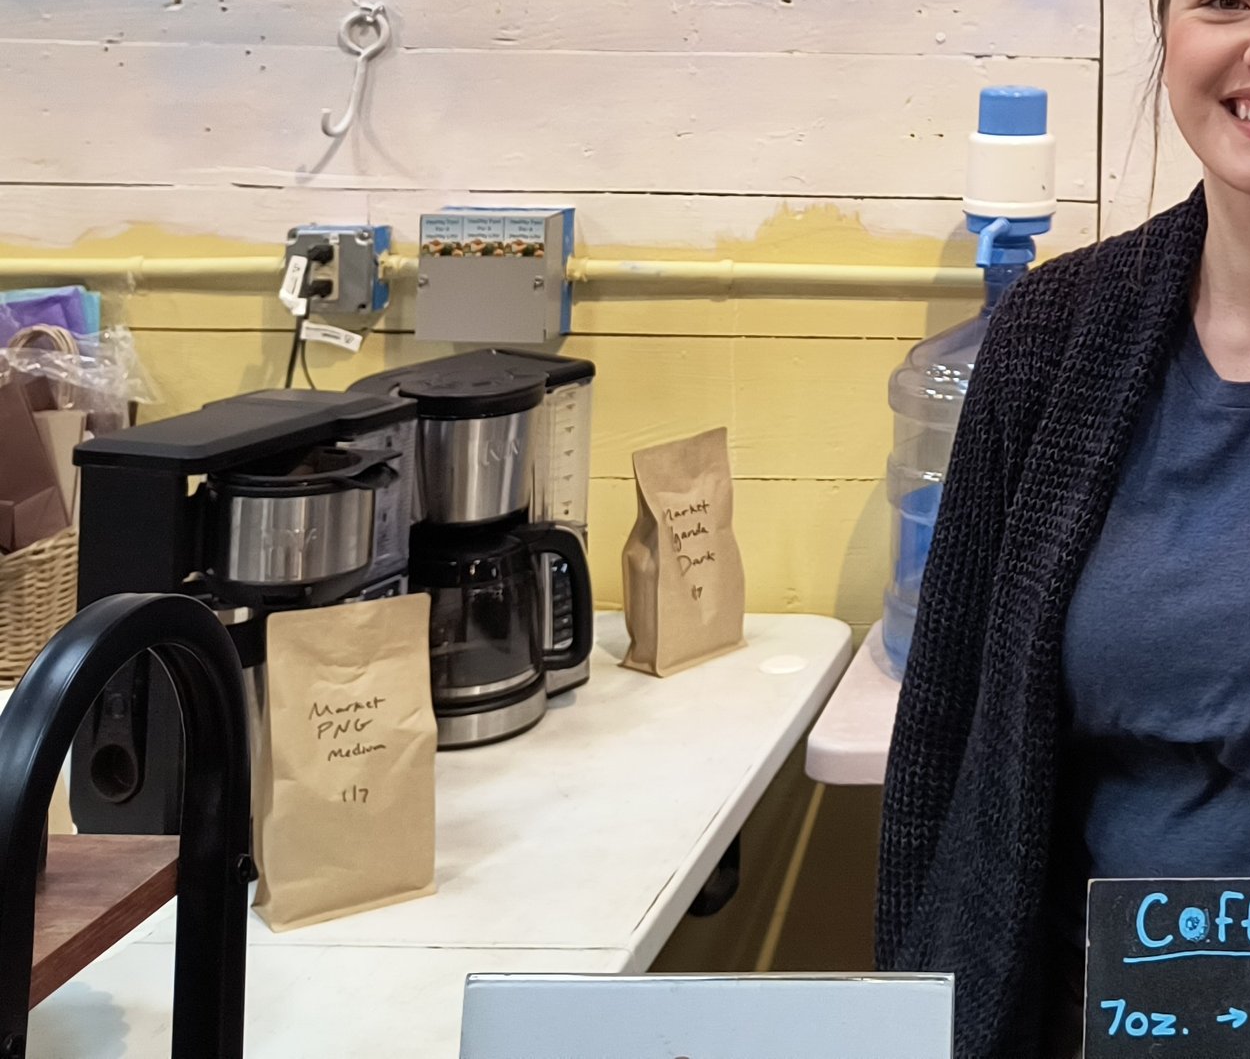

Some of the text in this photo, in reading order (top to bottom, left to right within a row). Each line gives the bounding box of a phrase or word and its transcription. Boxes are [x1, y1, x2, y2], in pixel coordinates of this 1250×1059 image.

[676, 551, 716, 577] Dark
[308, 696, 387, 721] Market
[317, 718, 374, 740] PNG
